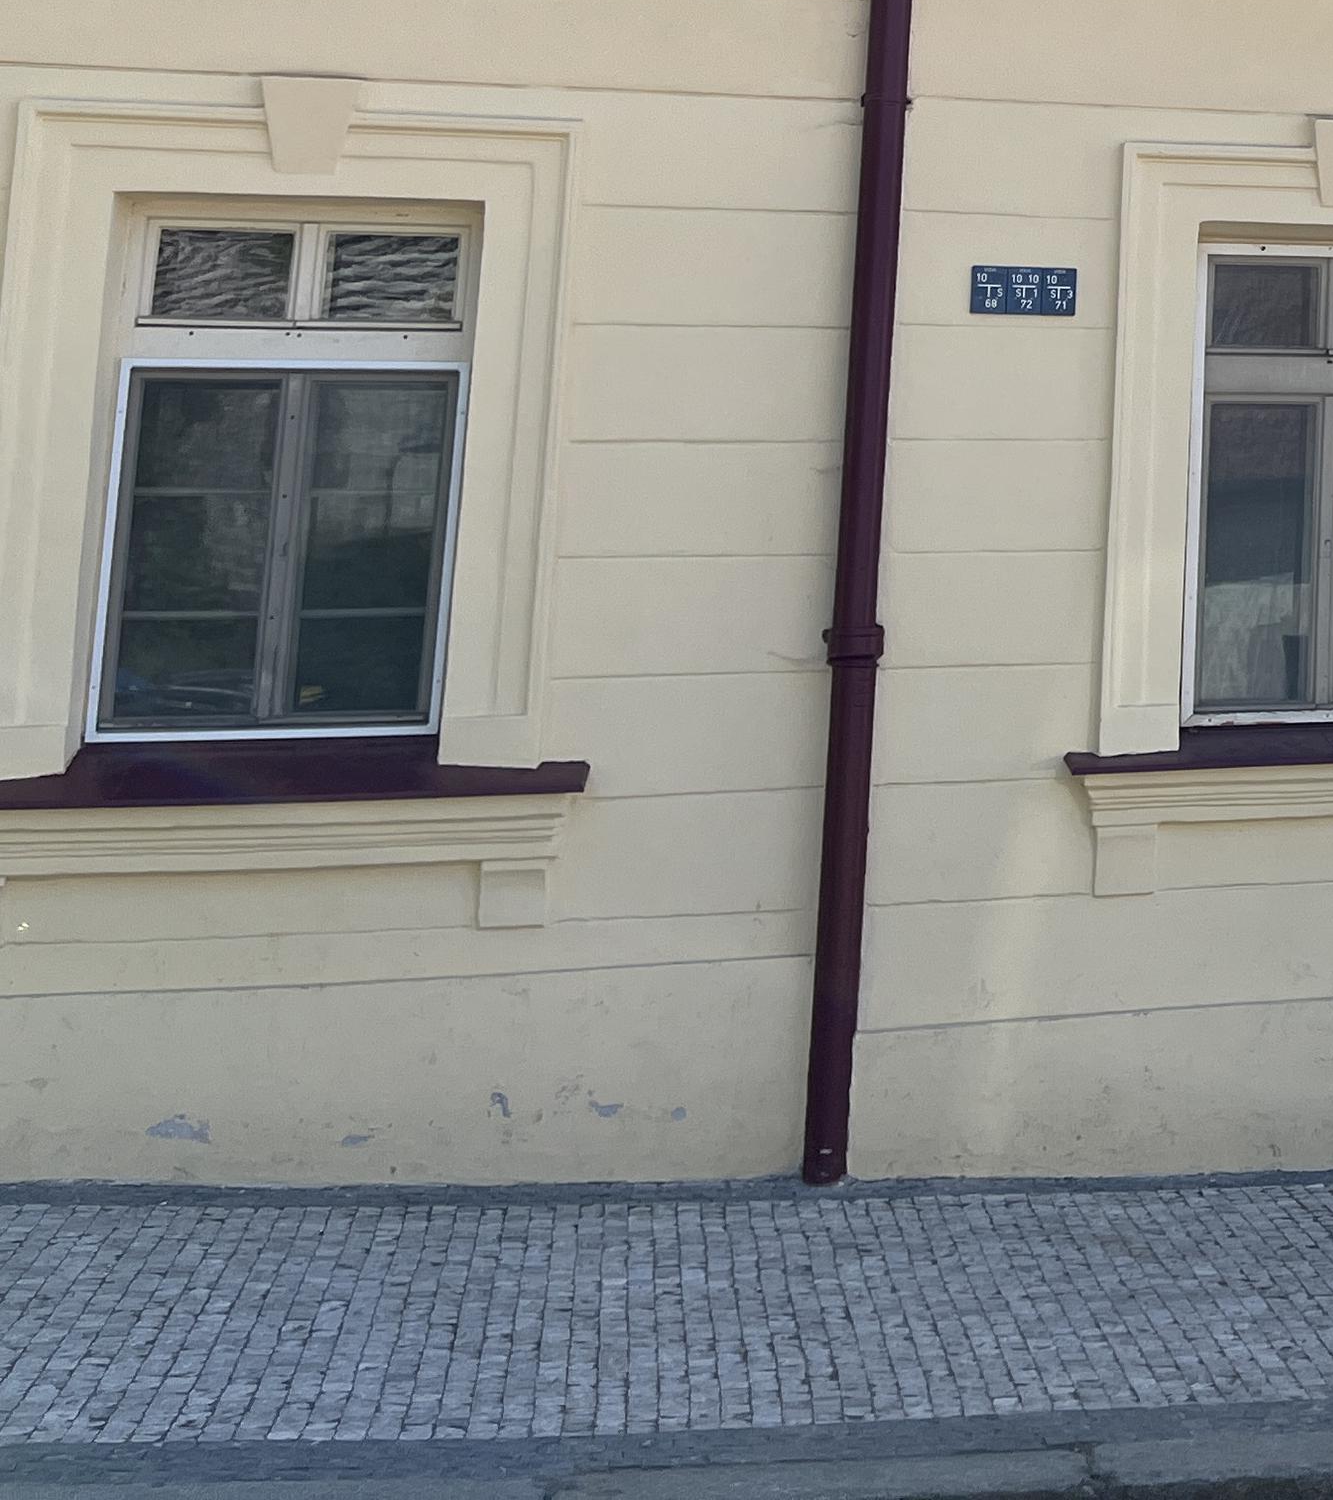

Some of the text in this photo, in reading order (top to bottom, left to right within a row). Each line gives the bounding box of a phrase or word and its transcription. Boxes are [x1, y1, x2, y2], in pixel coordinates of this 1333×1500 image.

[976, 273, 987, 283] 10
[1011, 274, 1039, 284] 10 10
[1046, 275, 1058, 284] 10
[1020, 300, 1033, 309] 72
[1055, 301, 1067, 310] 71
